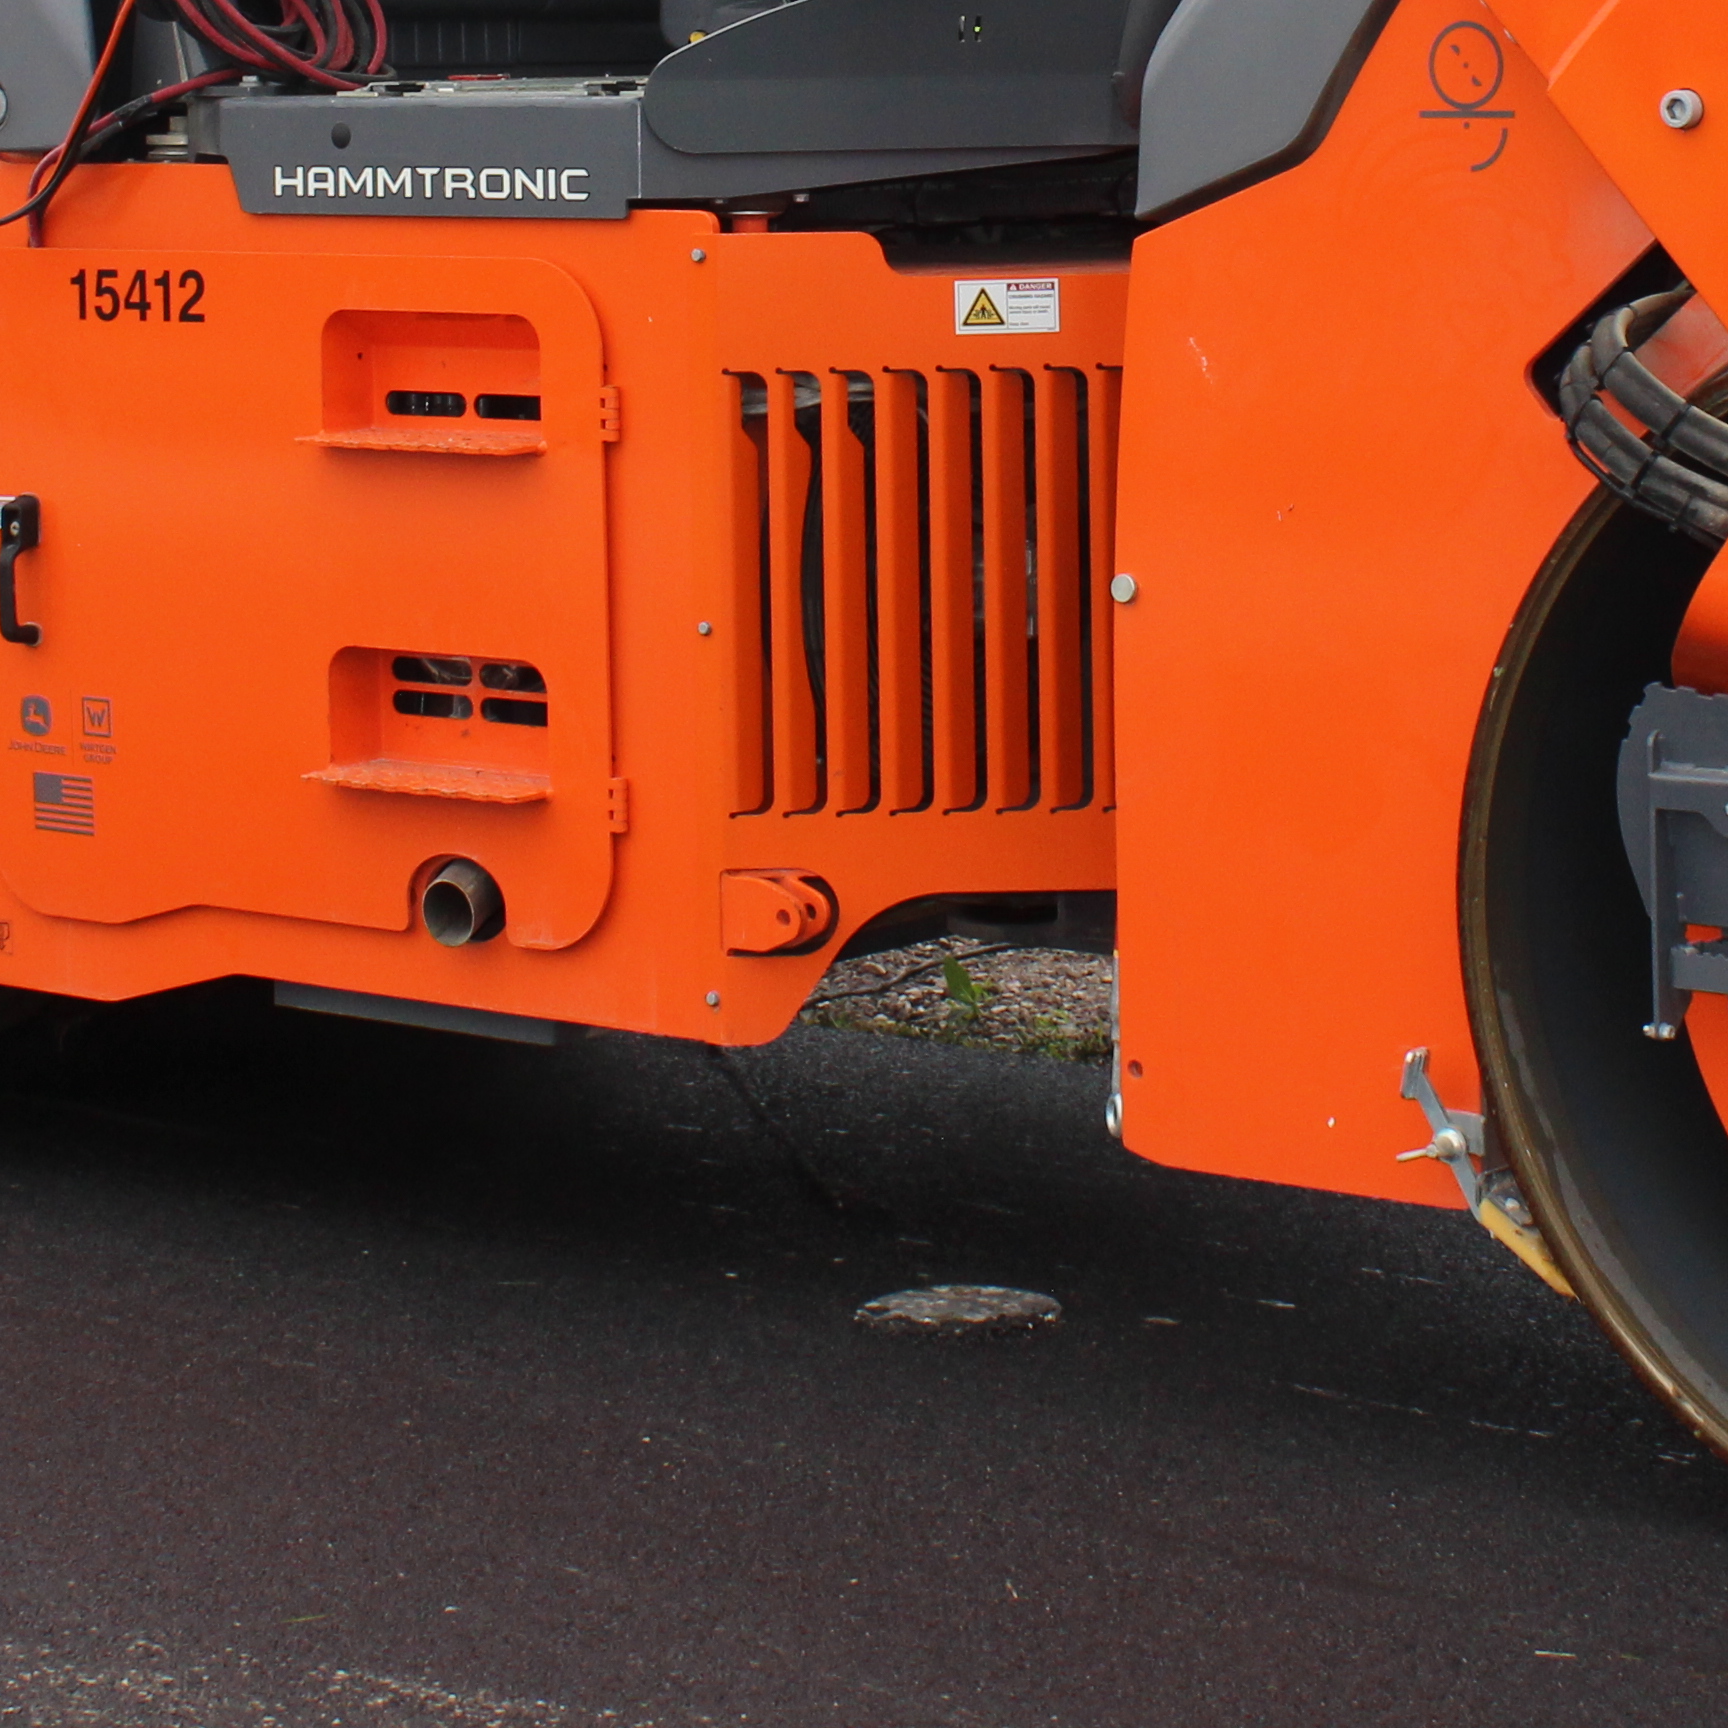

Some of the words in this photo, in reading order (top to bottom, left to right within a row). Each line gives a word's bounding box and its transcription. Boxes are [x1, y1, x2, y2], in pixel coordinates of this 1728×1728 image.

[274, 165, 590, 202] HAMMTRONIC
[70, 269, 206, 322] 15412
[1019, 282, 1052, 290] DANGER
